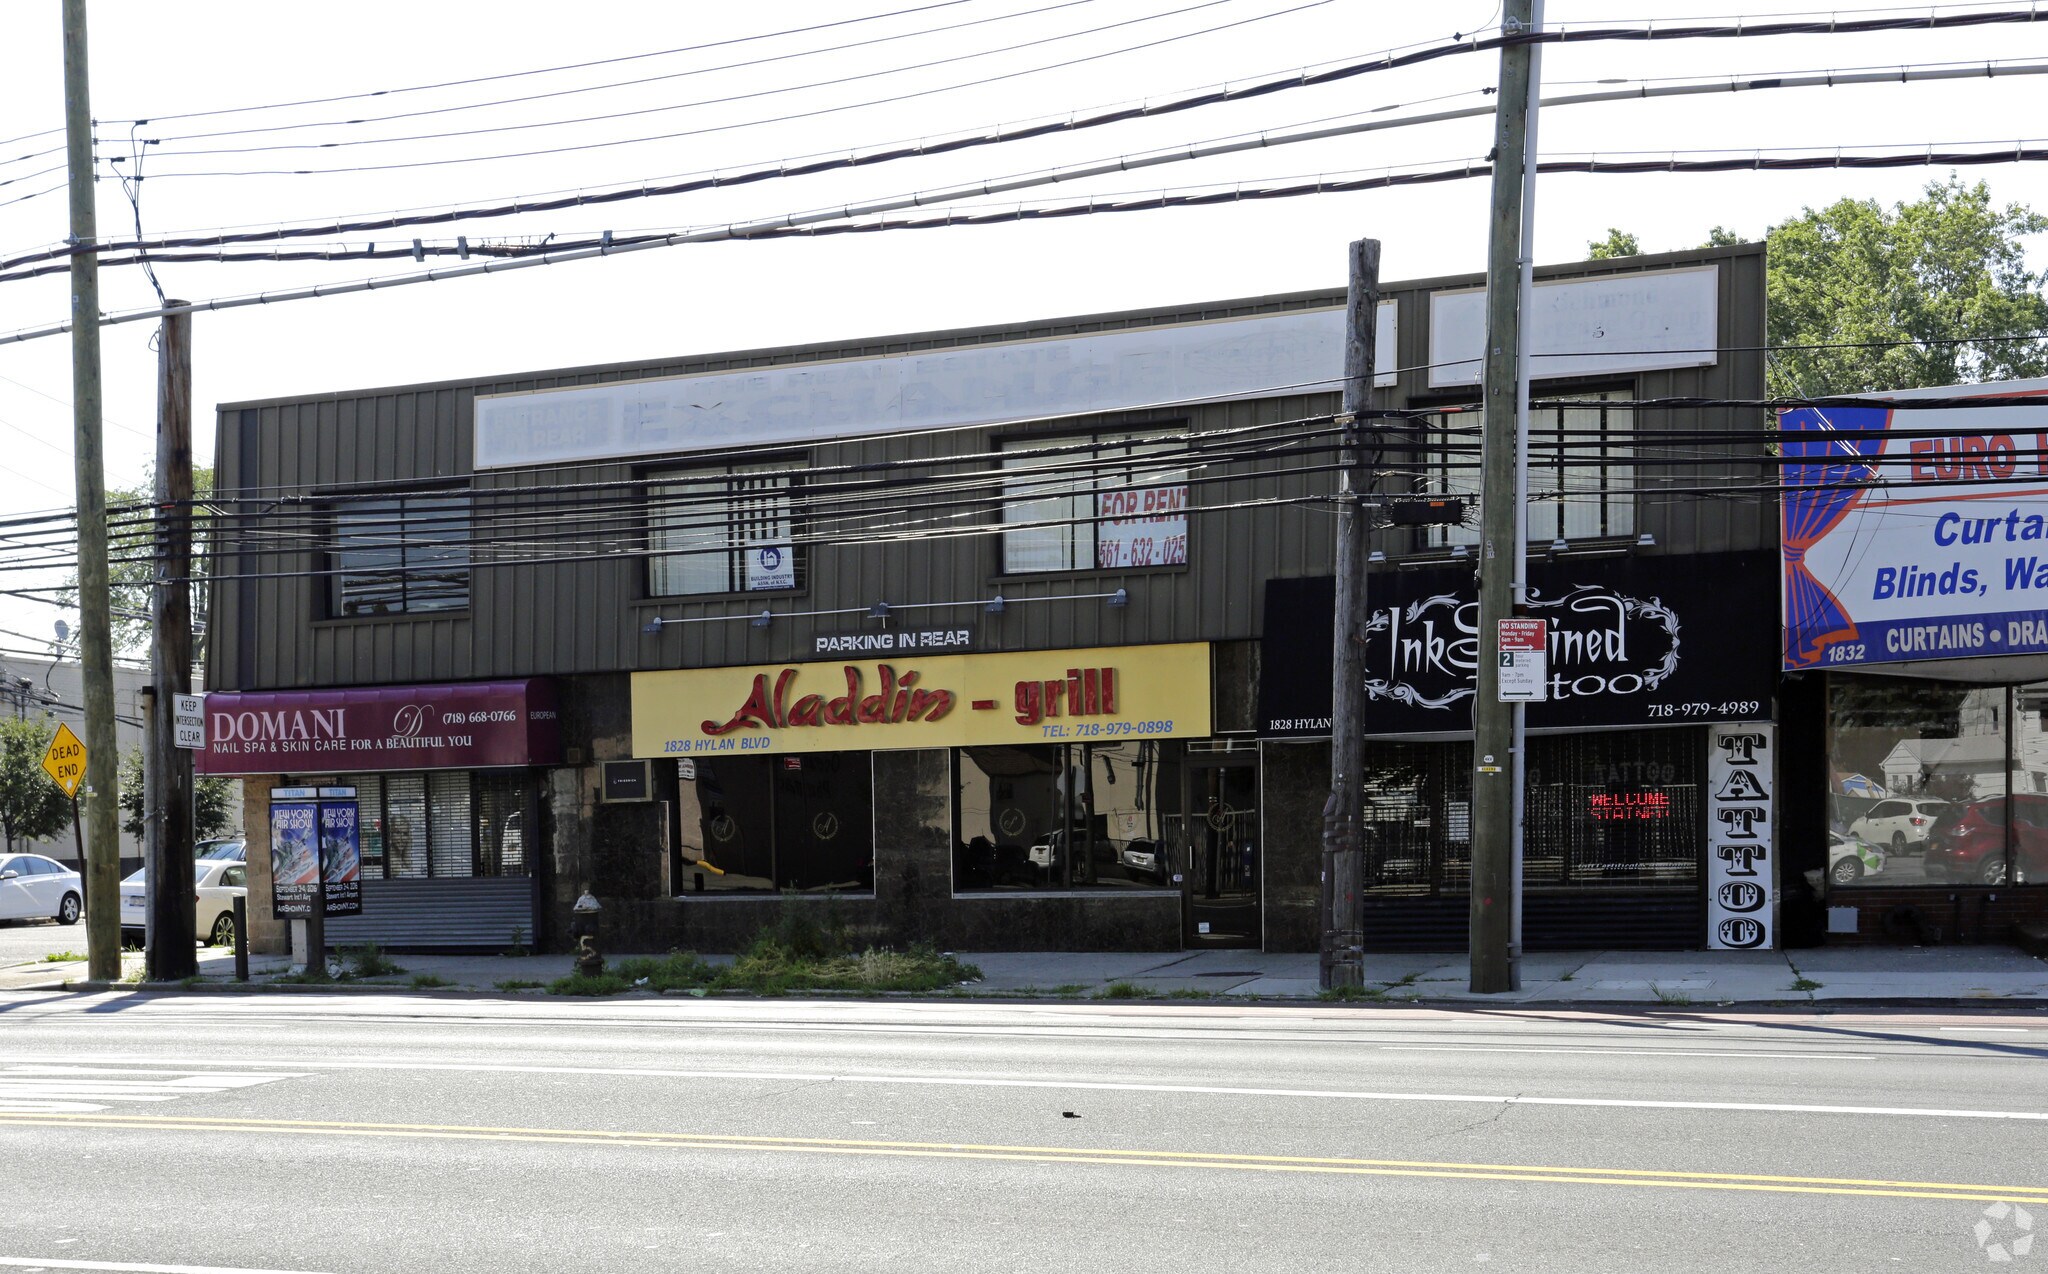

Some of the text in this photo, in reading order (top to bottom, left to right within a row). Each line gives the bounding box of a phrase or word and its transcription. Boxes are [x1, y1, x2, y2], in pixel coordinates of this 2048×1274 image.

[1909, 433, 2016, 482] EURO
[1100, 492, 1138, 526] FOR
[1934, 508, 2048, 547] Curta
[1131, 537, 1153, 567] 632
[1872, 561, 1988, 600] Blinds,
[816, 629, 971, 653] PARKING IN REAR
[1886, 622, 1984, 653] CURTAINS
[1503, 653, 1510, 666] 2
[1828, 644, 1865, 662] 1832
[181, 700, 197, 712] KEEP
[701, 663, 956, 736] Aladdin
[1014, 667, 1119, 725] grill
[443, 710, 517, 726] (718) 668-0766
[530, 711, 557, 720] EUROPEAN
[1647, 700, 1759, 718] 718-979-4989
[175, 715, 203, 728] INTERSECTION
[212, 708, 347, 742] DOMANI
[1042, 720, 1174, 738] TEL: 718-979-0898
[1269, 717, 1332, 731] 1828 HYLAN
[179, 730, 201, 742] CLEAR
[213, 735, 472, 754] NAIL SPA & SKIN CARE FOR A BEAUTIFUL YOU
[664, 736, 771, 754] 1828 HYLAN BLVD
[52, 743, 80, 761] DEAD
[58, 763, 79, 778] END
[1594, 762, 1676, 784] TATTOO
[283, 789, 306, 797] TITAN
[329, 788, 347, 796] TITAN
[274, 809, 314, 819] NEW YORK
[323, 807, 355, 818] NEW YORK
[276, 819, 289, 829] AIR
[324, 818, 336, 828] AIR
[1714, 732, 1770, 949] TATTOO
